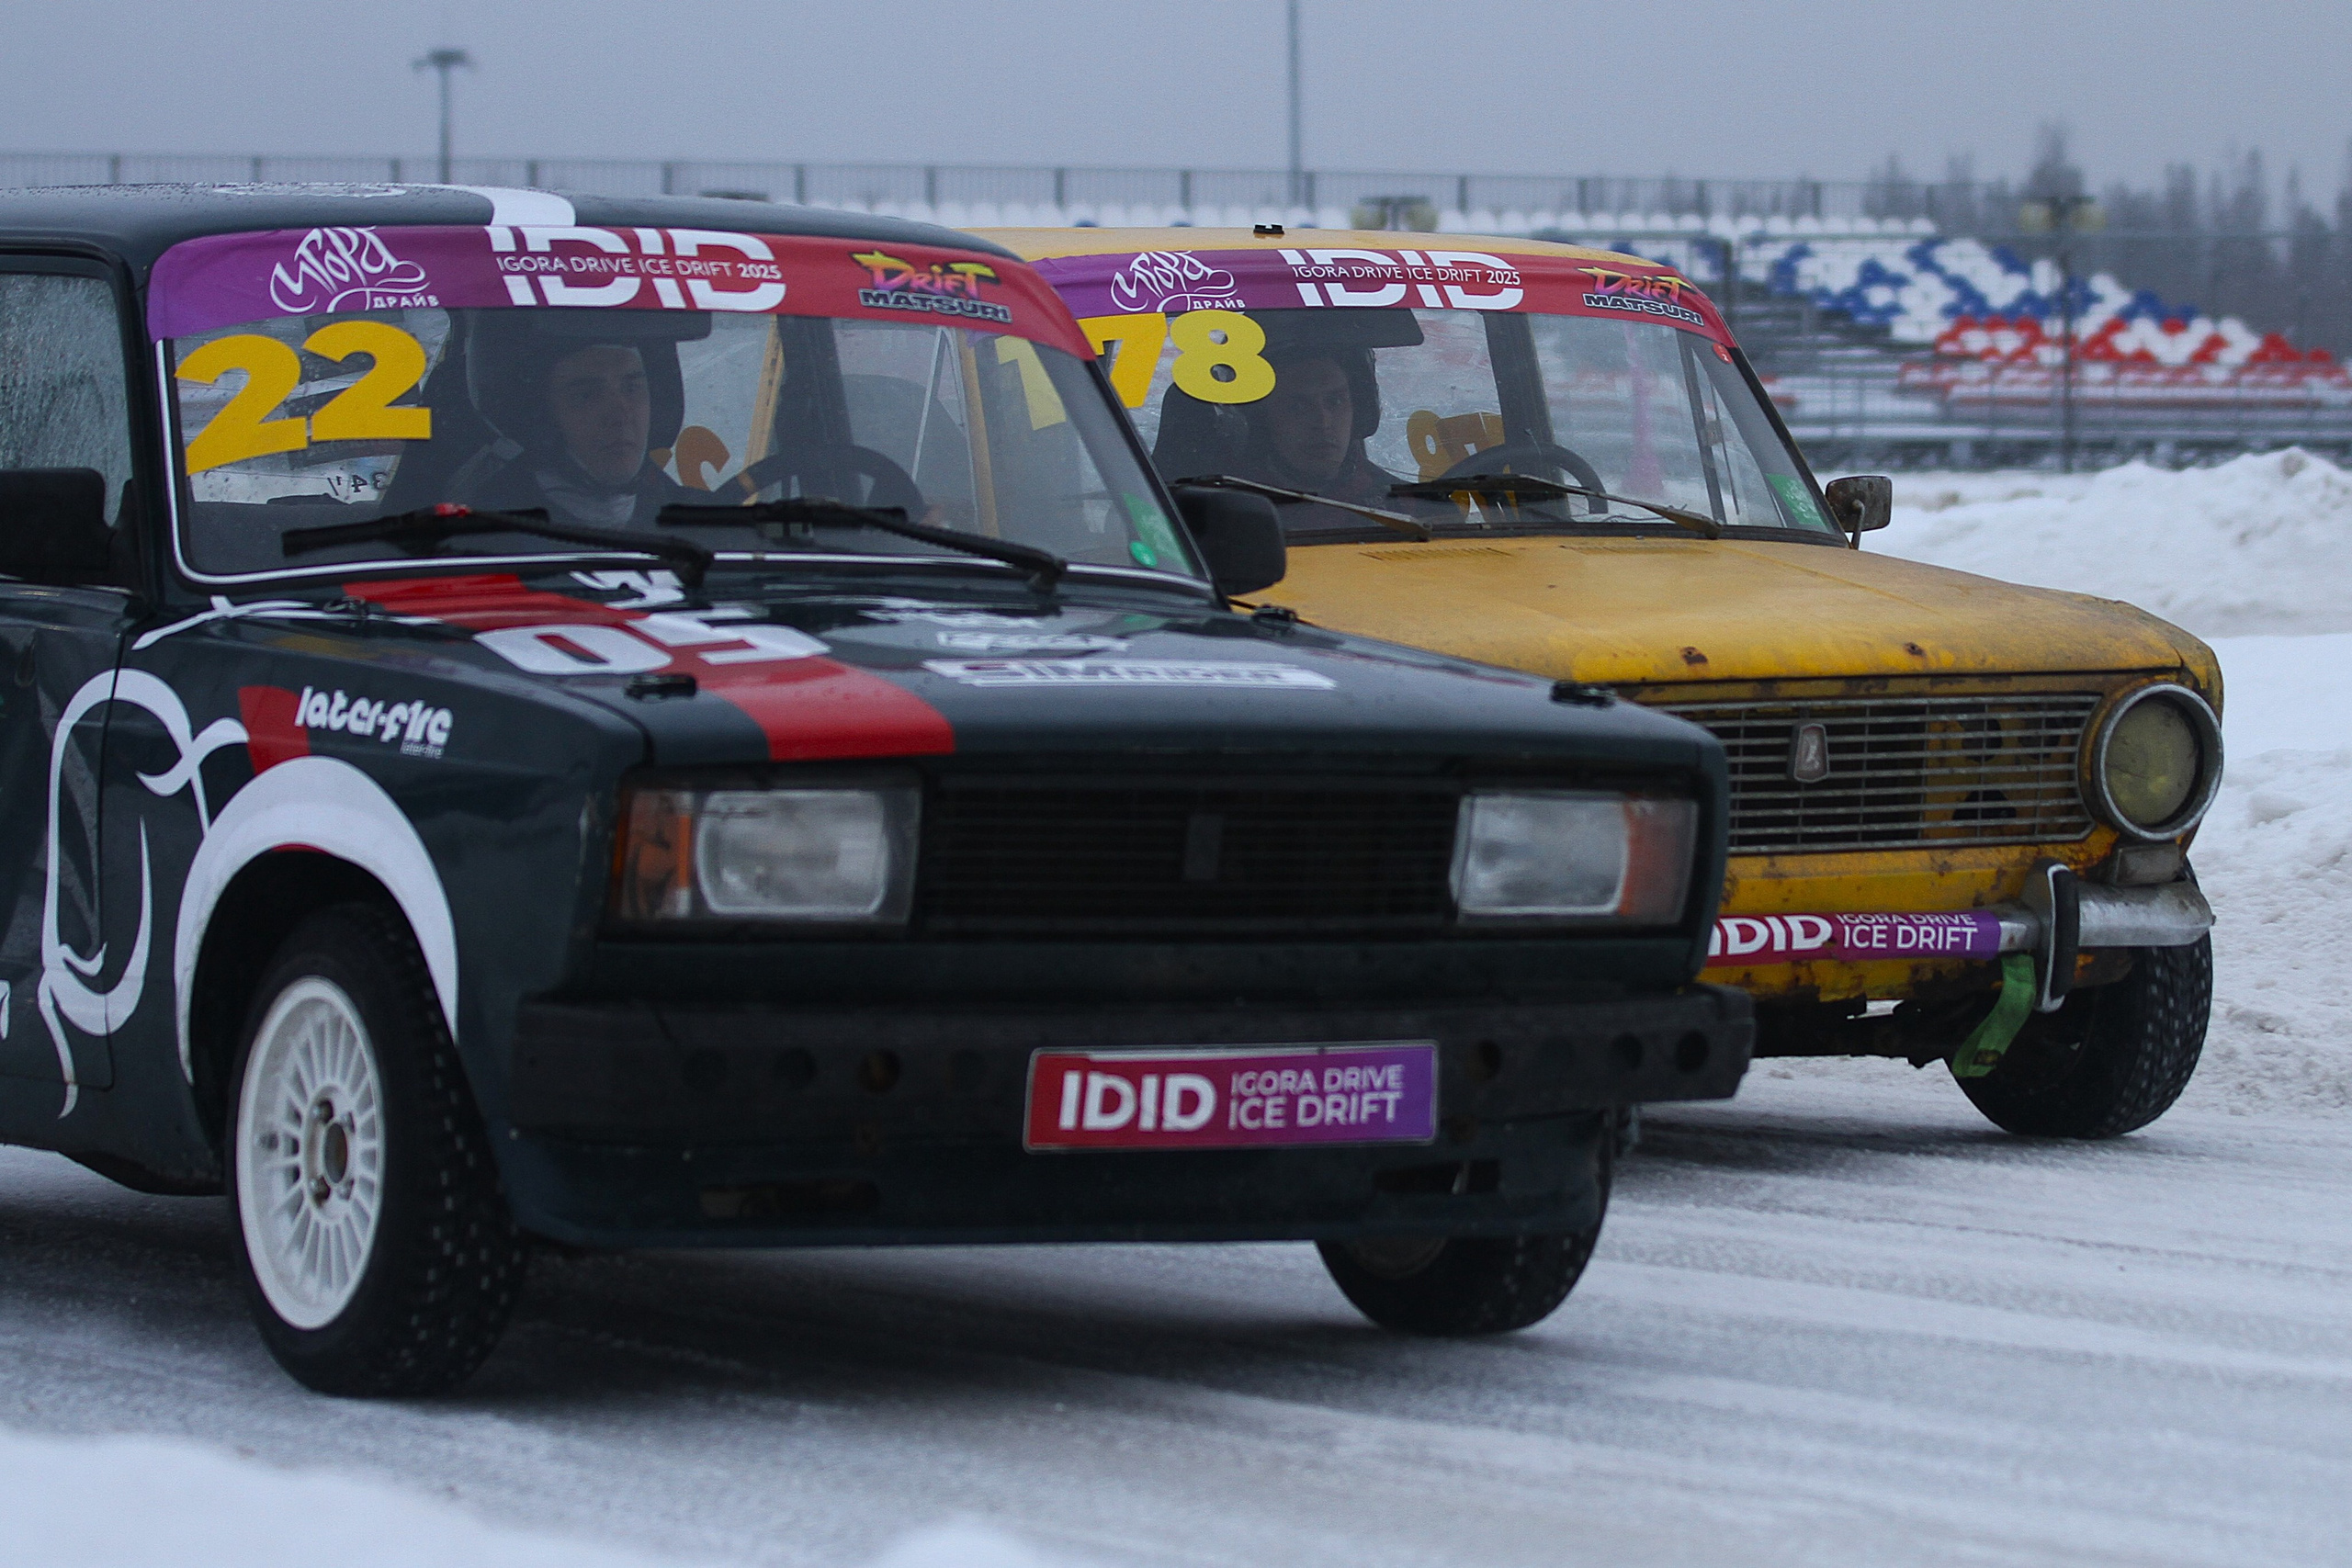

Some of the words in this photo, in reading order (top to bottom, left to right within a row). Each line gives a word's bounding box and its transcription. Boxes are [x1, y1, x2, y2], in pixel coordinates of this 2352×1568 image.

[496, 256, 569, 273] IGORA
[571, 256, 636, 275] DRIVE
[639, 258, 674, 276] ICE
[675, 260, 733, 278] DRIFT
[736, 263, 783, 280] 2025
[1292, 265, 1351, 279] IGORA
[1351, 265, 1404, 280] DRIVE
[1406, 267, 1434, 281] ICE
[1437, 267, 1482, 283] DRIFT
[1486, 269, 1521, 286] 2025
[372, 292, 440, 310] ДРАЙВ
[858, 288, 1012, 323] MATSURI
[1193, 297, 1246, 310] ДРАЙВ
[1583, 293, 1705, 326] MATSURI
[173, 319, 433, 477] 22
[1844, 925, 1888, 948] ICE
[1896, 926, 1978, 951] DRIFT
[1231, 1069, 1317, 1097] IGORA
[1324, 1064, 1405, 1093] DRIVE
[1058, 1070, 1217, 1132] IDID
[1229, 1098, 1286, 1131] ICE
[1297, 1091, 1404, 1127] DRIFT
